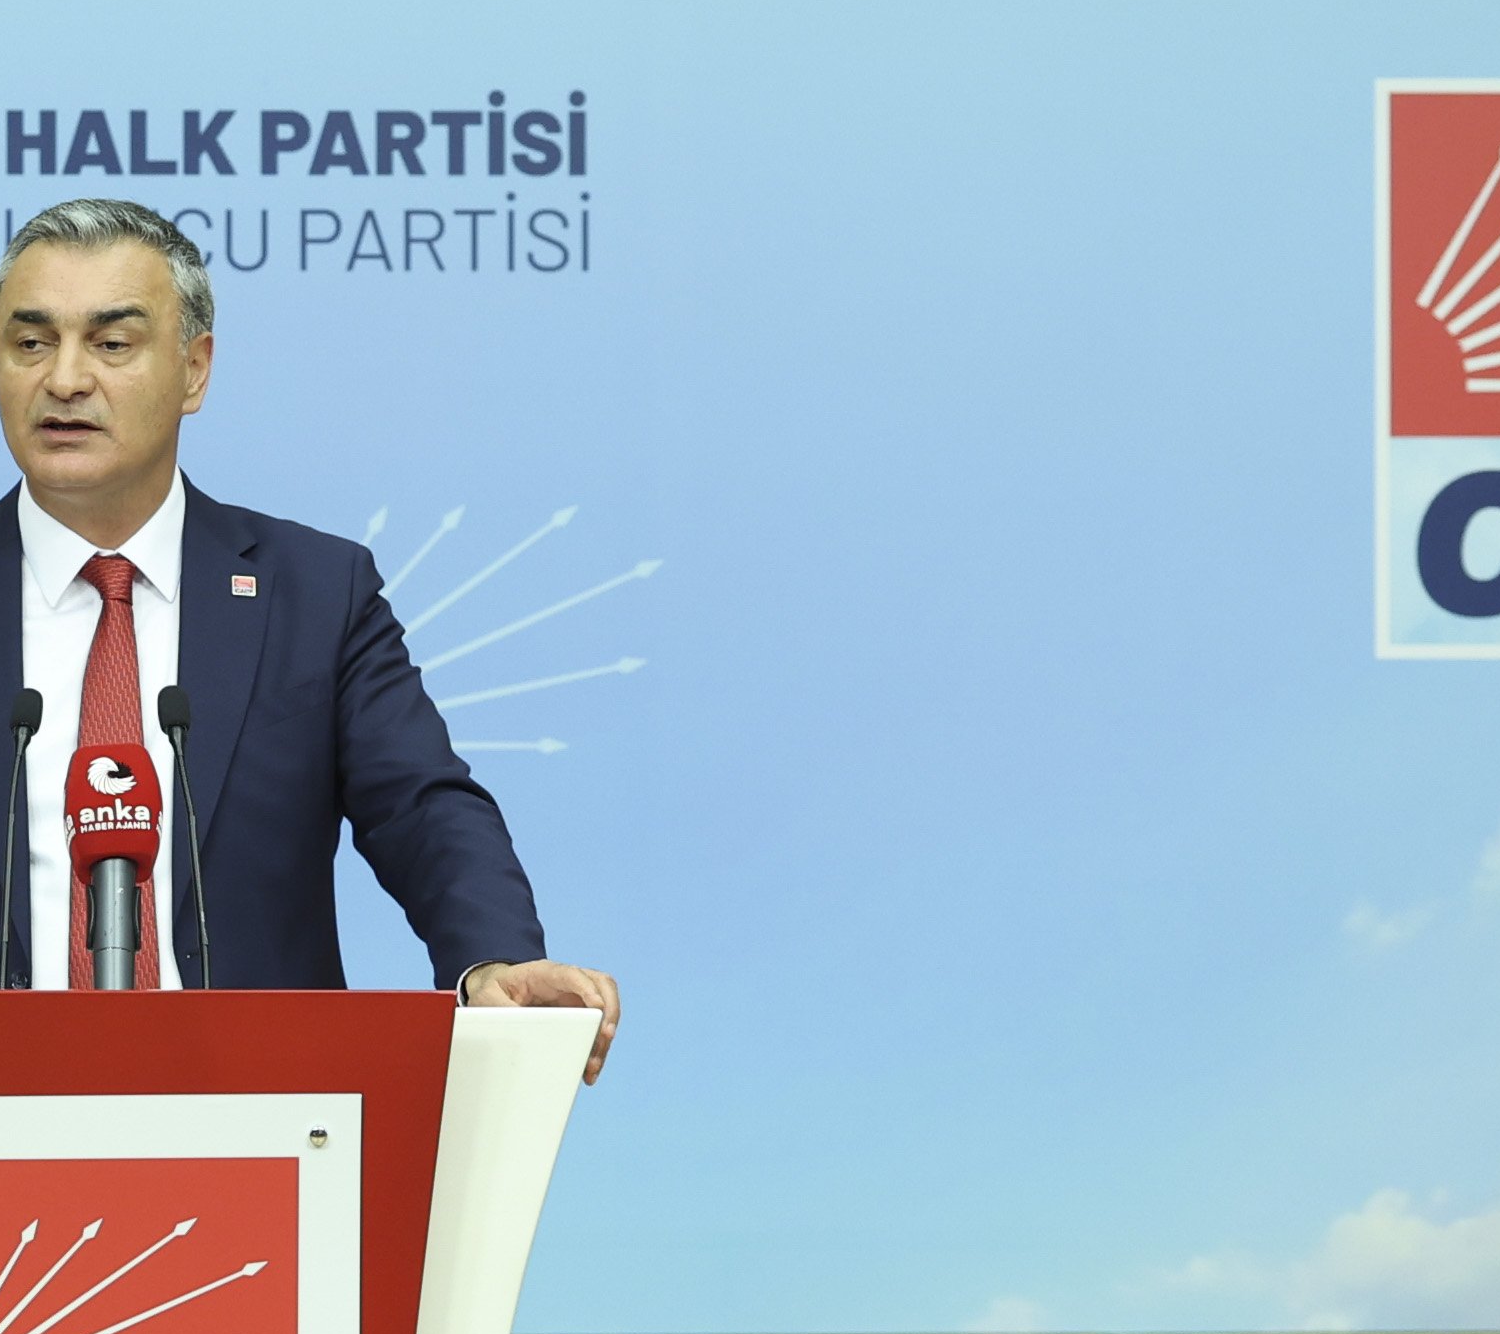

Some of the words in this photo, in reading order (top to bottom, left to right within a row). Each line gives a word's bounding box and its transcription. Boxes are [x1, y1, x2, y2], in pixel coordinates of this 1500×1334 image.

[6, 109, 237, 176] HALK
[259, 89, 588, 177] PARTİSİ
[299, 191, 591, 273] PARTİSİ
[79, 798, 150, 823] anka
[80, 822, 114, 834] HABER
[115, 821, 151, 831] AJANSI
